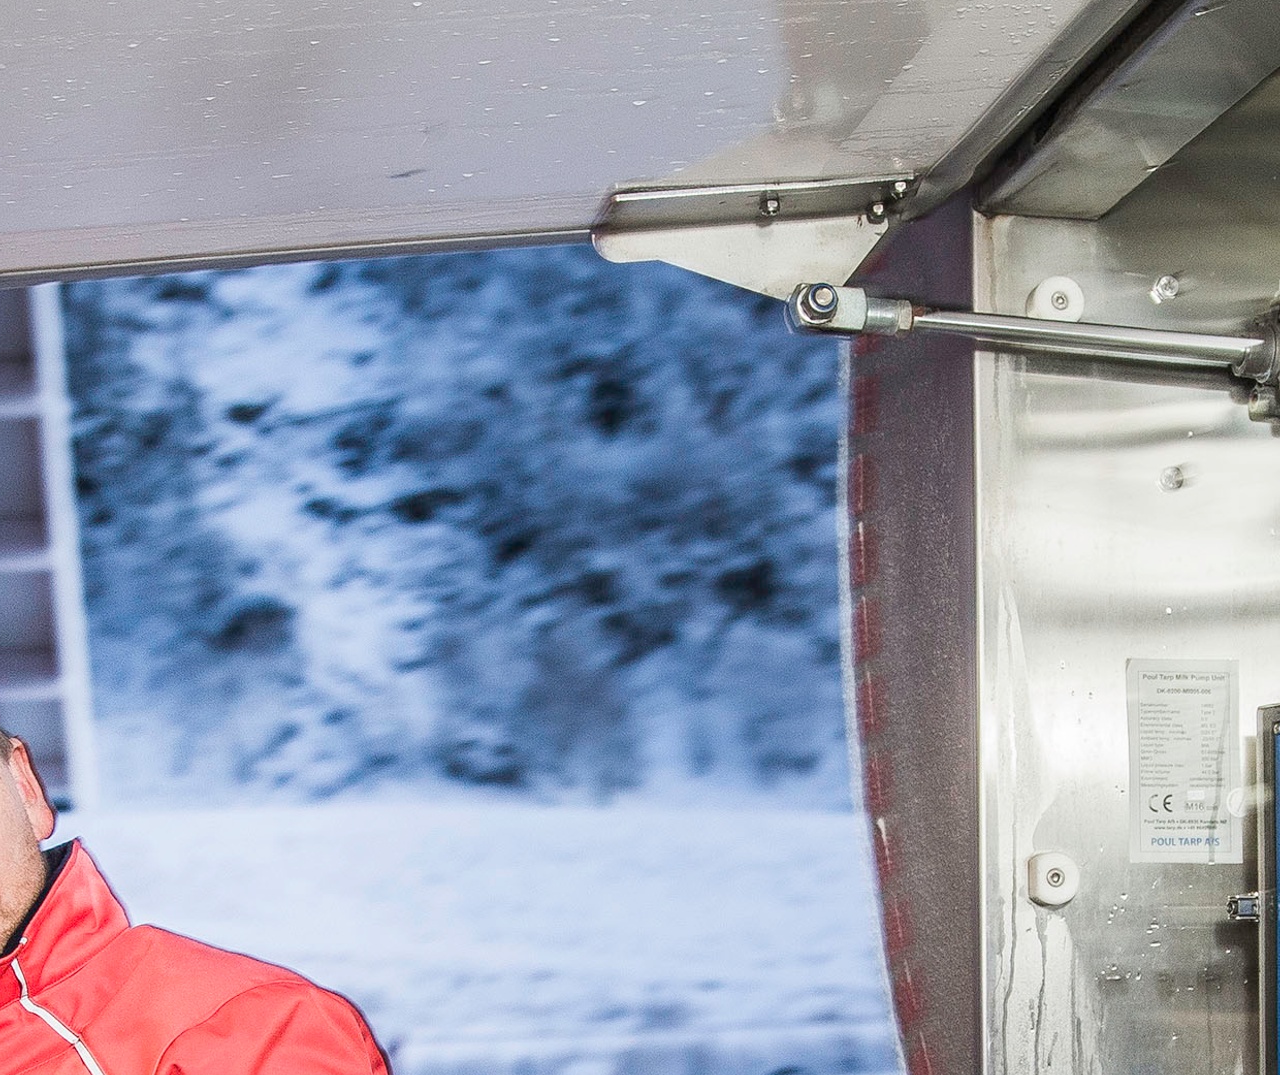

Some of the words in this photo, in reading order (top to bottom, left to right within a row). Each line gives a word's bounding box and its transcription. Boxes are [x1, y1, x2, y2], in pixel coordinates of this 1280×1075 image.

[1142, 673, 1158, 681] Poul
[1159, 673, 1174, 682] Tarp
[1175, 673, 1189, 681] Milk
[1190, 674, 1210, 682] Pump
[1150, 837, 1176, 846] POUL
[1178, 837, 1203, 846] TARP
[1204, 837, 1221, 846] A/S
